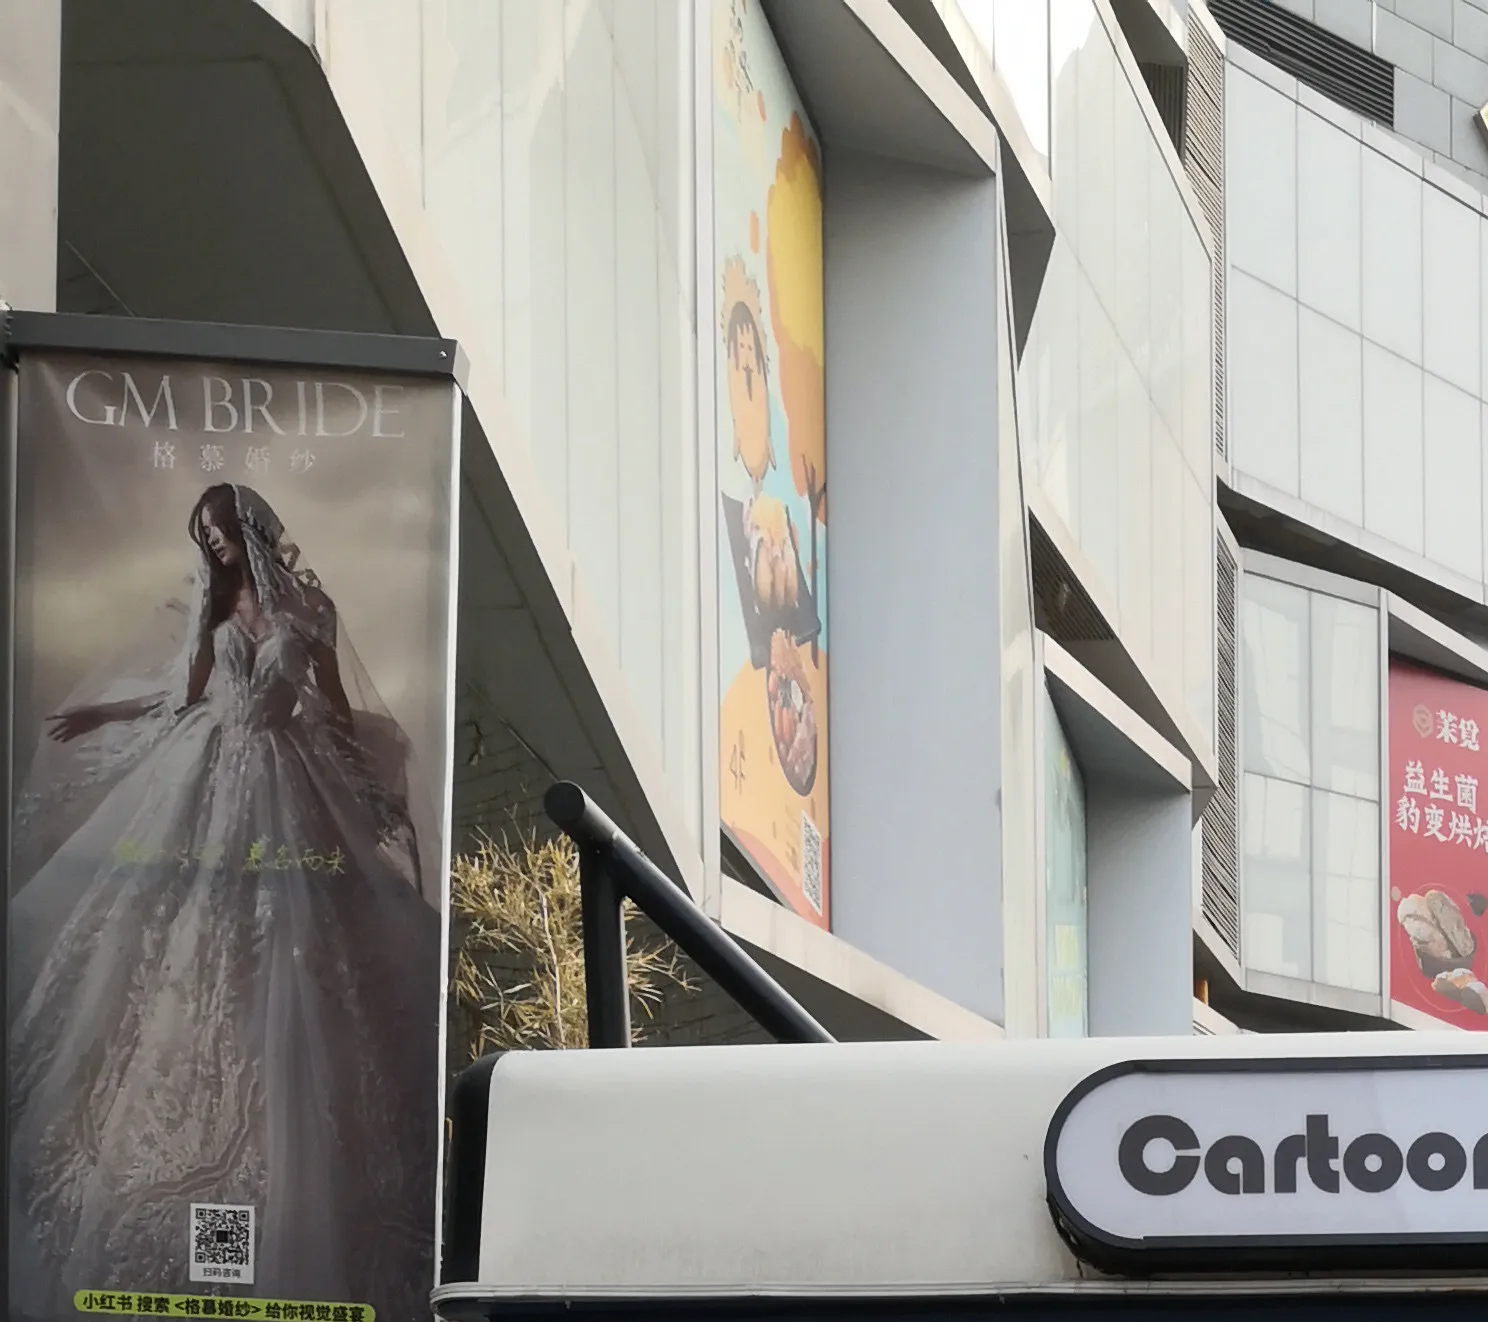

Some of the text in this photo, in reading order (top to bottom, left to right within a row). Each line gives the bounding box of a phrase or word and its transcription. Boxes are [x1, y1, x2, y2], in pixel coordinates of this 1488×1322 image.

[66, 370, 405, 438] GM BRIDE
[1404, 760, 1478, 815] 益生菌
[83, 1293, 132, 1312] 小红书
[137, 1296, 170, 1314] 搜索
[265, 1302, 365, 1322] 给你视觉盛宴
